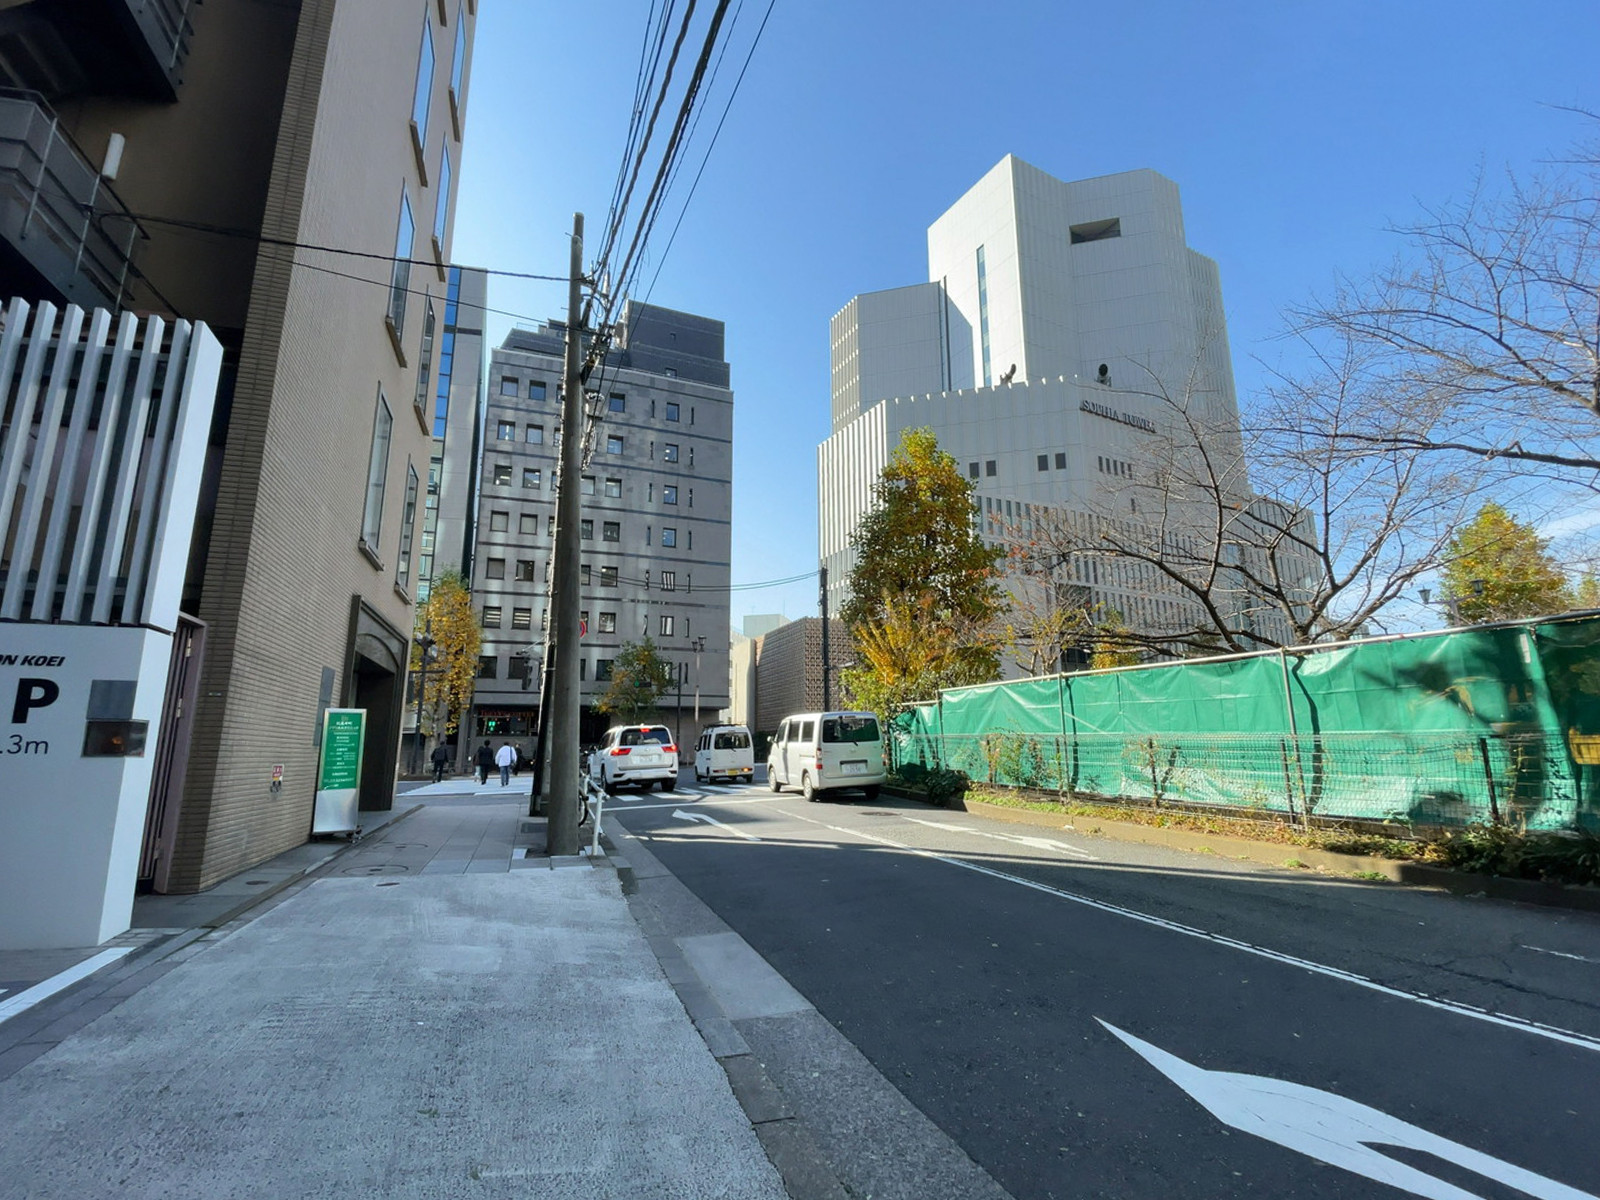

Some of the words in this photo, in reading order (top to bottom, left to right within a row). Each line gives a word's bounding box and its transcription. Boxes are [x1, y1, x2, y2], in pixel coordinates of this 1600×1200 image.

[0, 654, 19, 666] N
[20, 655, 66, 667] KOEI
[11, 677, 60, 724] P
